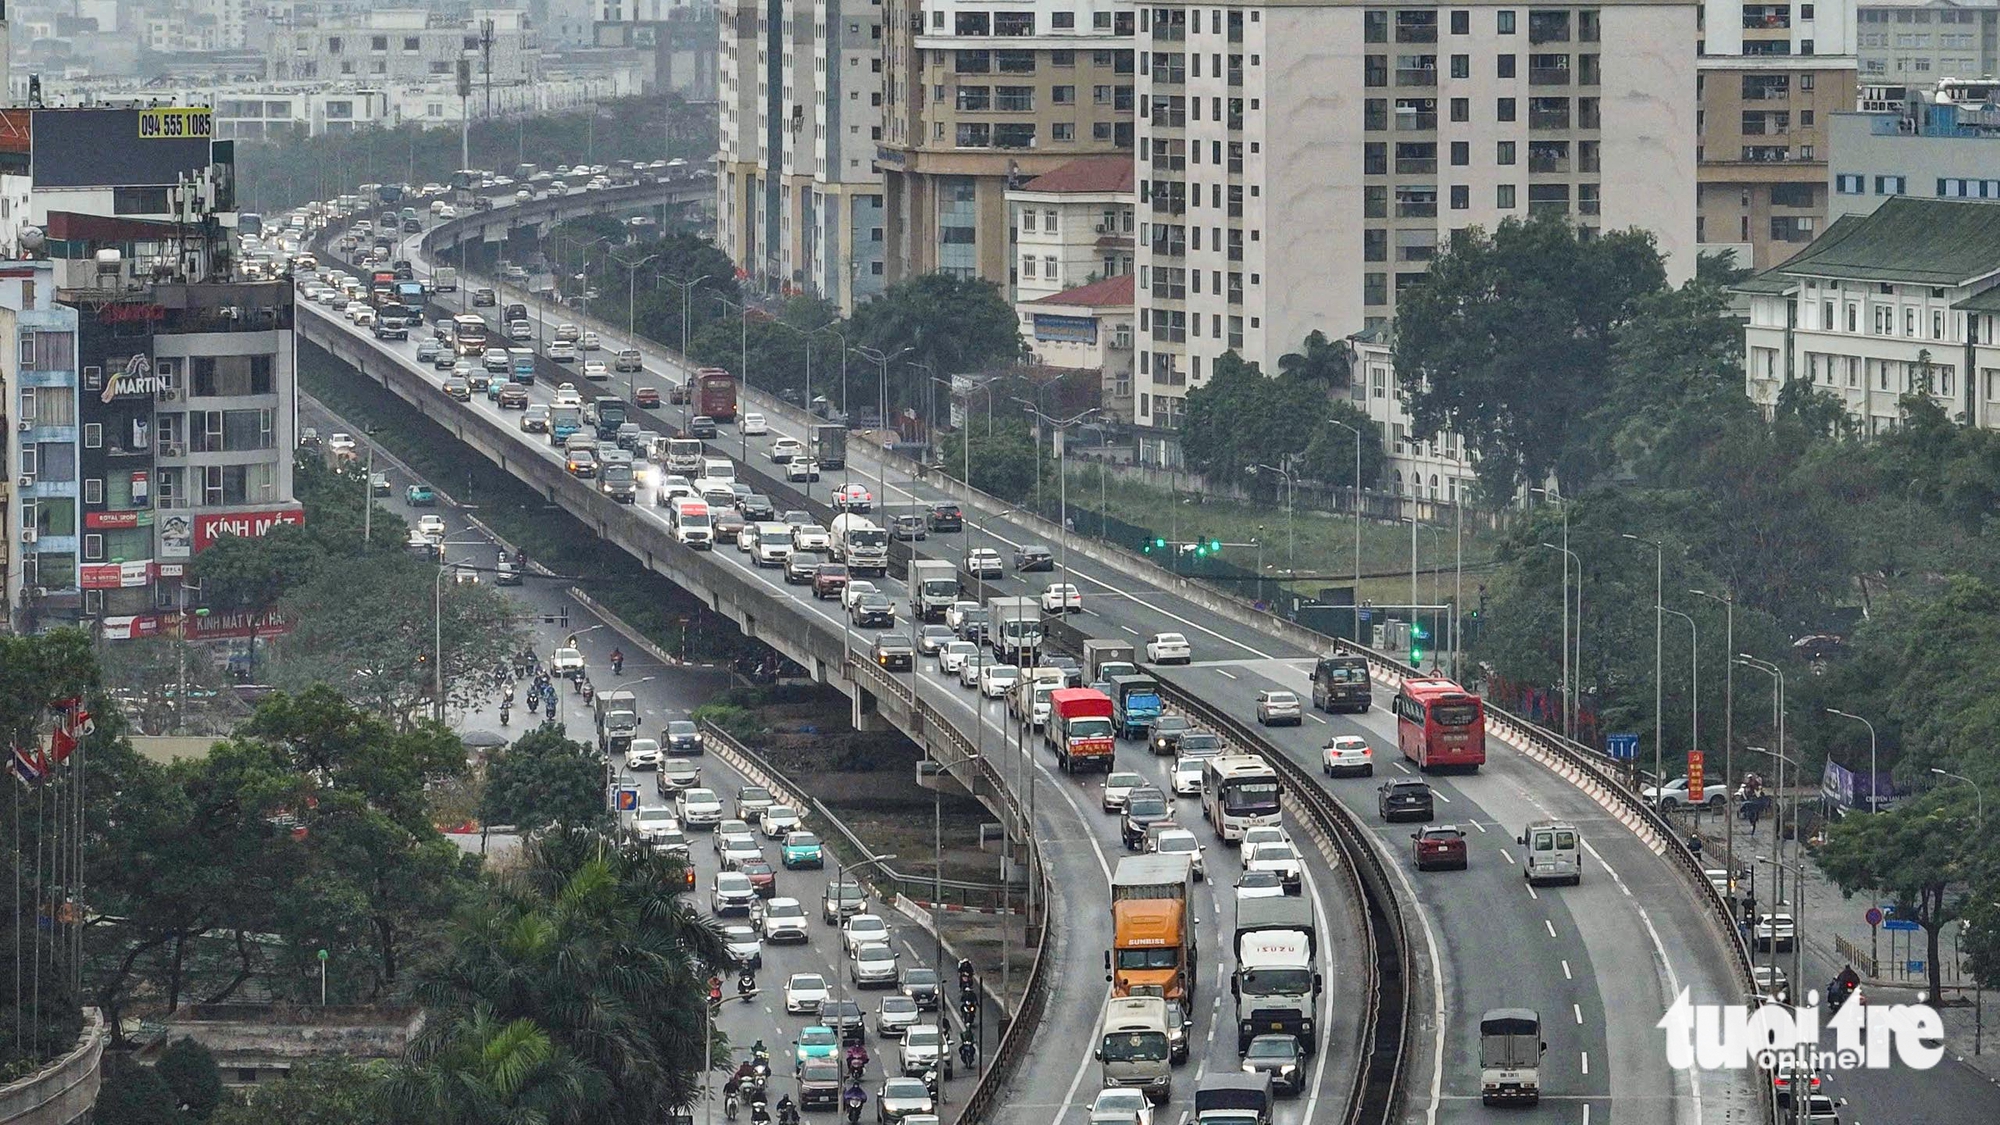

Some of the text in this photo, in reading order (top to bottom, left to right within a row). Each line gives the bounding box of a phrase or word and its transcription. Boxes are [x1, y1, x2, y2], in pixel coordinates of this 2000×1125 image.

[141, 114, 211, 136] 094 555 1085
[114, 376, 166, 395] MARTIN
[205, 517, 249, 539] KÍNH
[1128, 938, 1165, 946] SUNRISE
